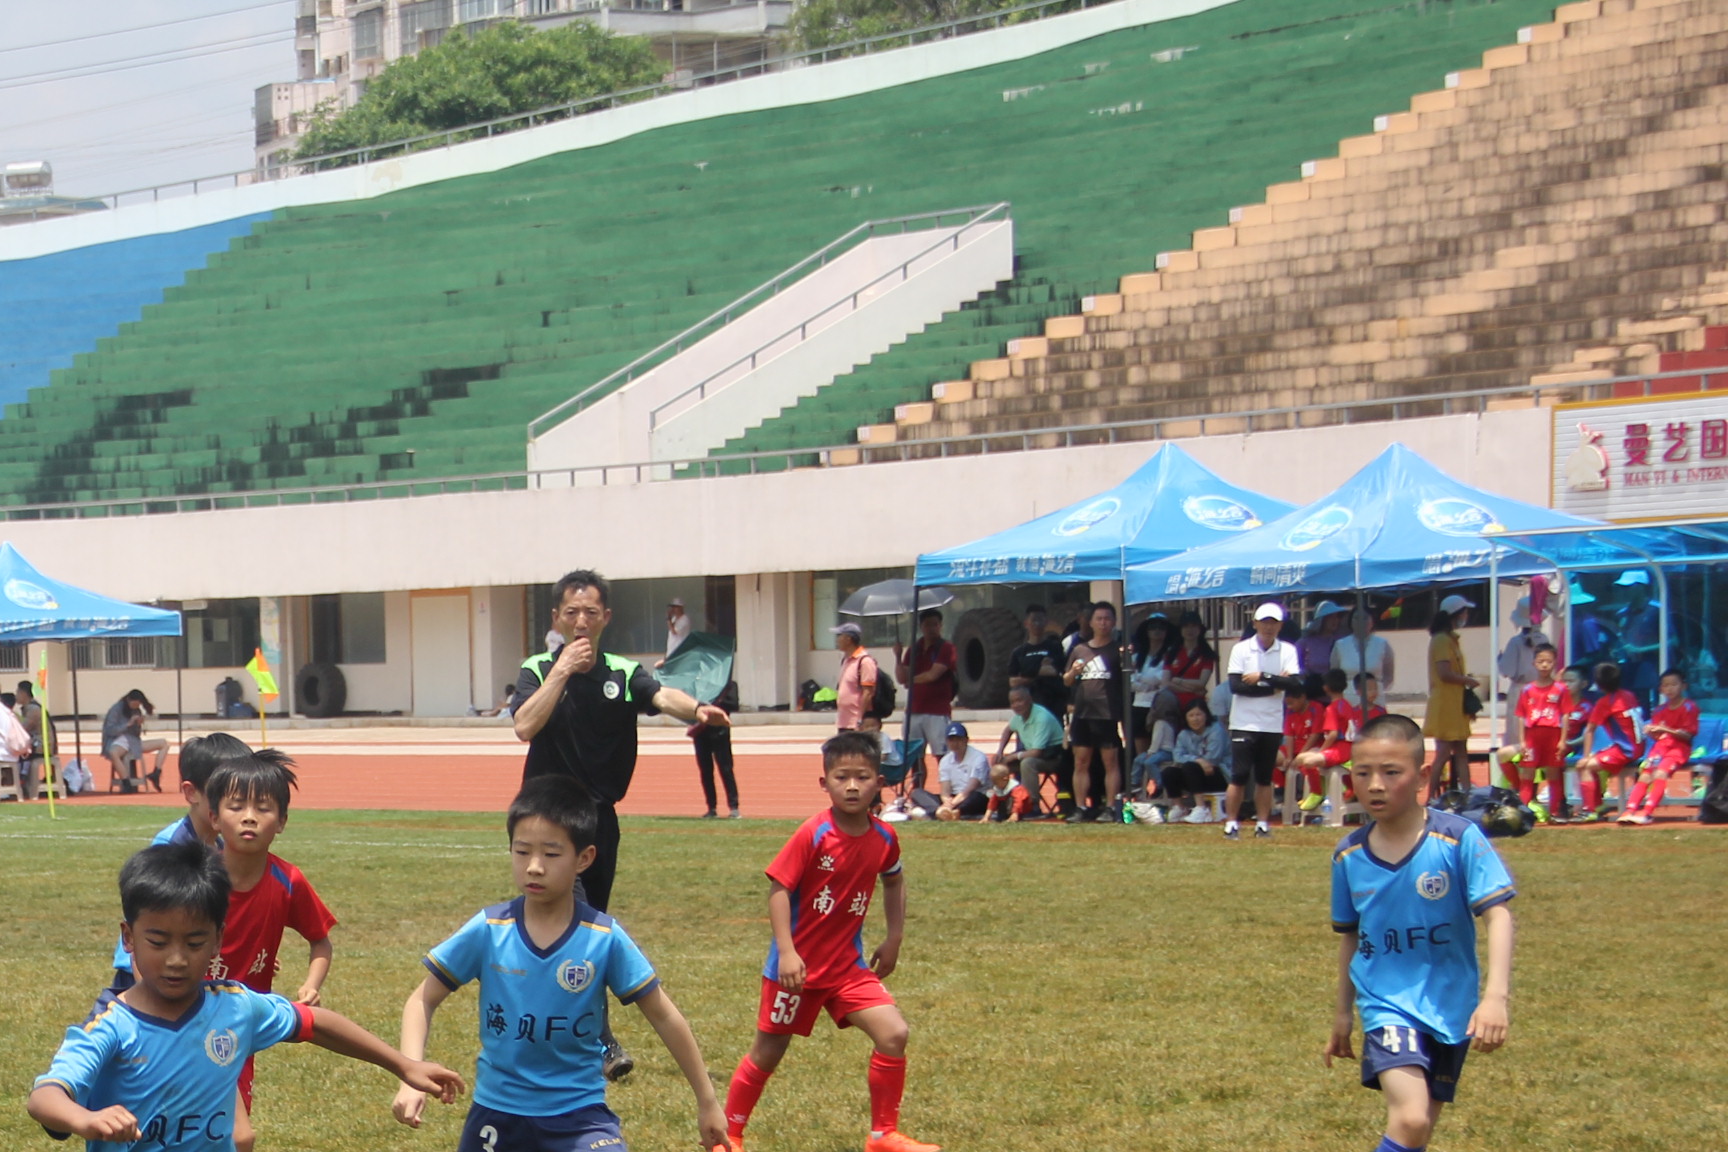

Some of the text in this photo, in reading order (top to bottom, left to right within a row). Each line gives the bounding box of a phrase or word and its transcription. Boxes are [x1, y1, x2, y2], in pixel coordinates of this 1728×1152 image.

[1624, 419, 1728, 466] 曼艺国
[812, 885, 867, 916] 南站
[486, 1002, 595, 1044] 海贝FC
[770, 990, 801, 1024] 53
[1381, 1025, 1417, 1054] 41
[590, 1137, 622, 1150] KELM
